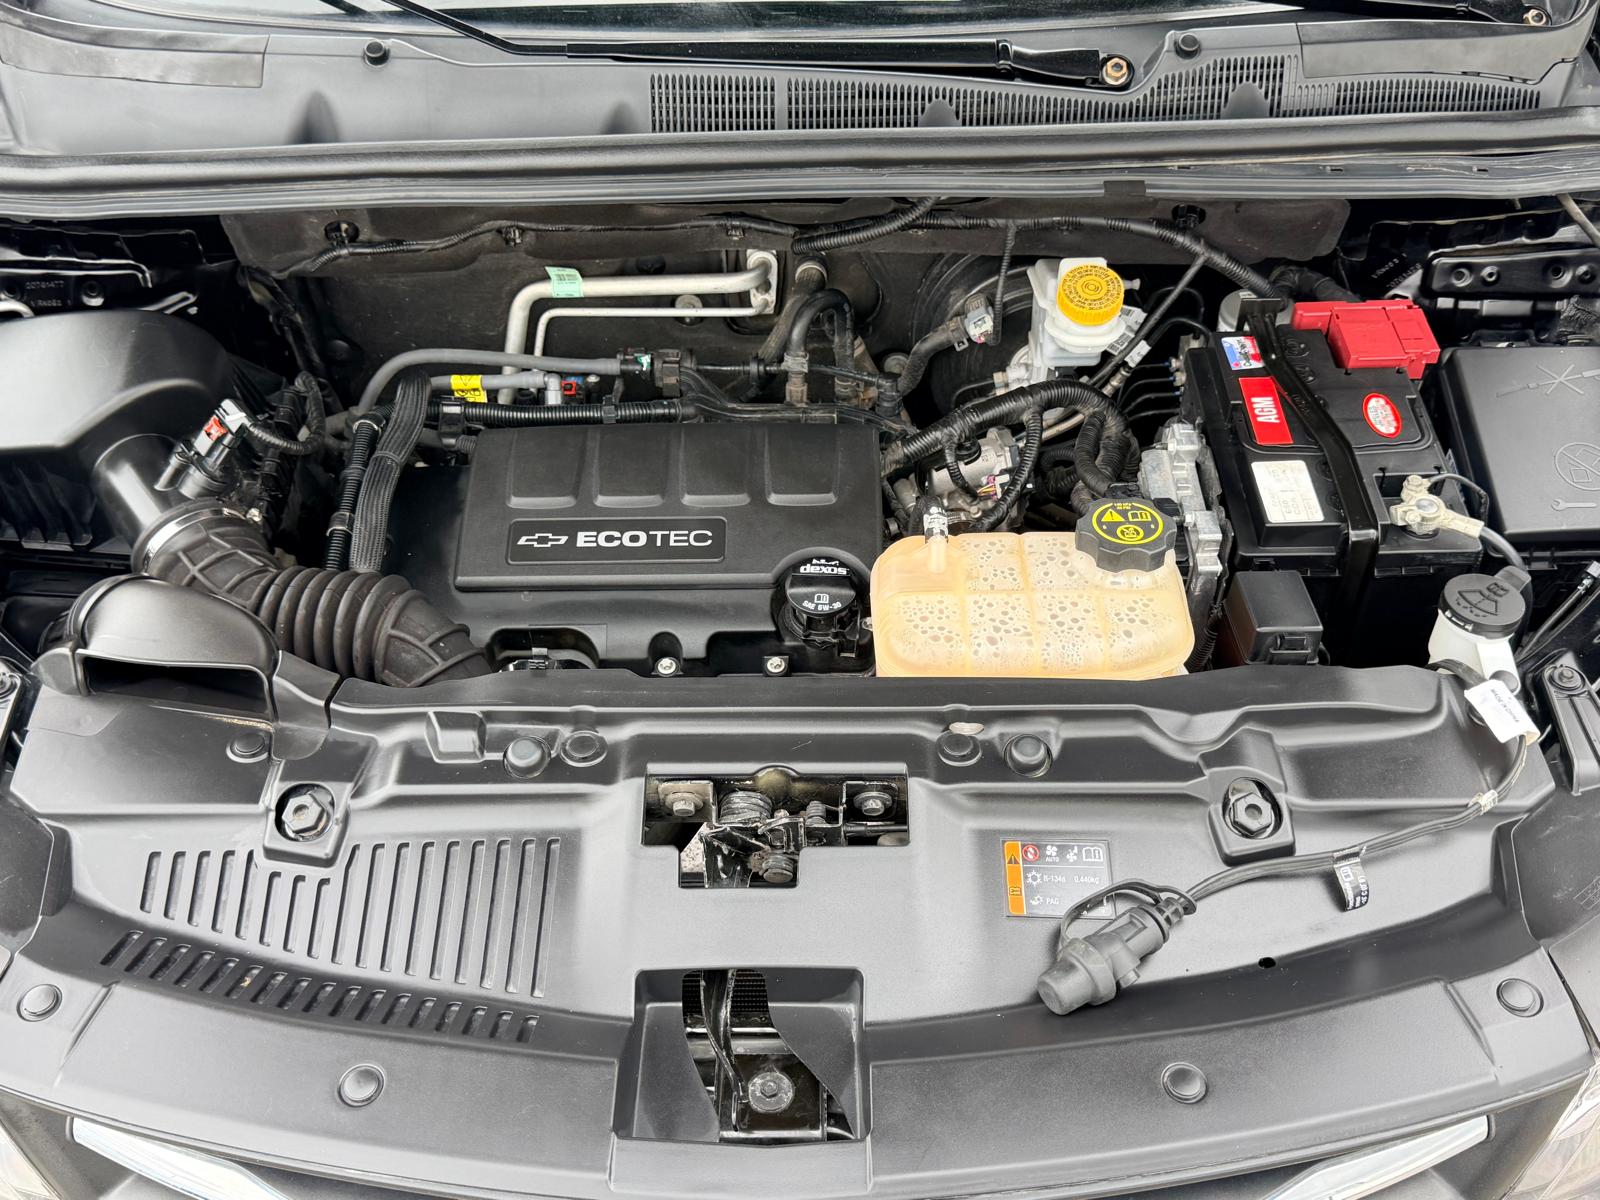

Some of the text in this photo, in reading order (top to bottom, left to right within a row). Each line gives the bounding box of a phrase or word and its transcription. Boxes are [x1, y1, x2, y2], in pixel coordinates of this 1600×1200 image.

[1250, 396, 1281, 424] AGM
[576, 529, 713, 547] ECOTEC
[799, 563, 848, 575] dexos
[802, 600, 816, 610] SAE
[1046, 897, 1060, 905] PAG
